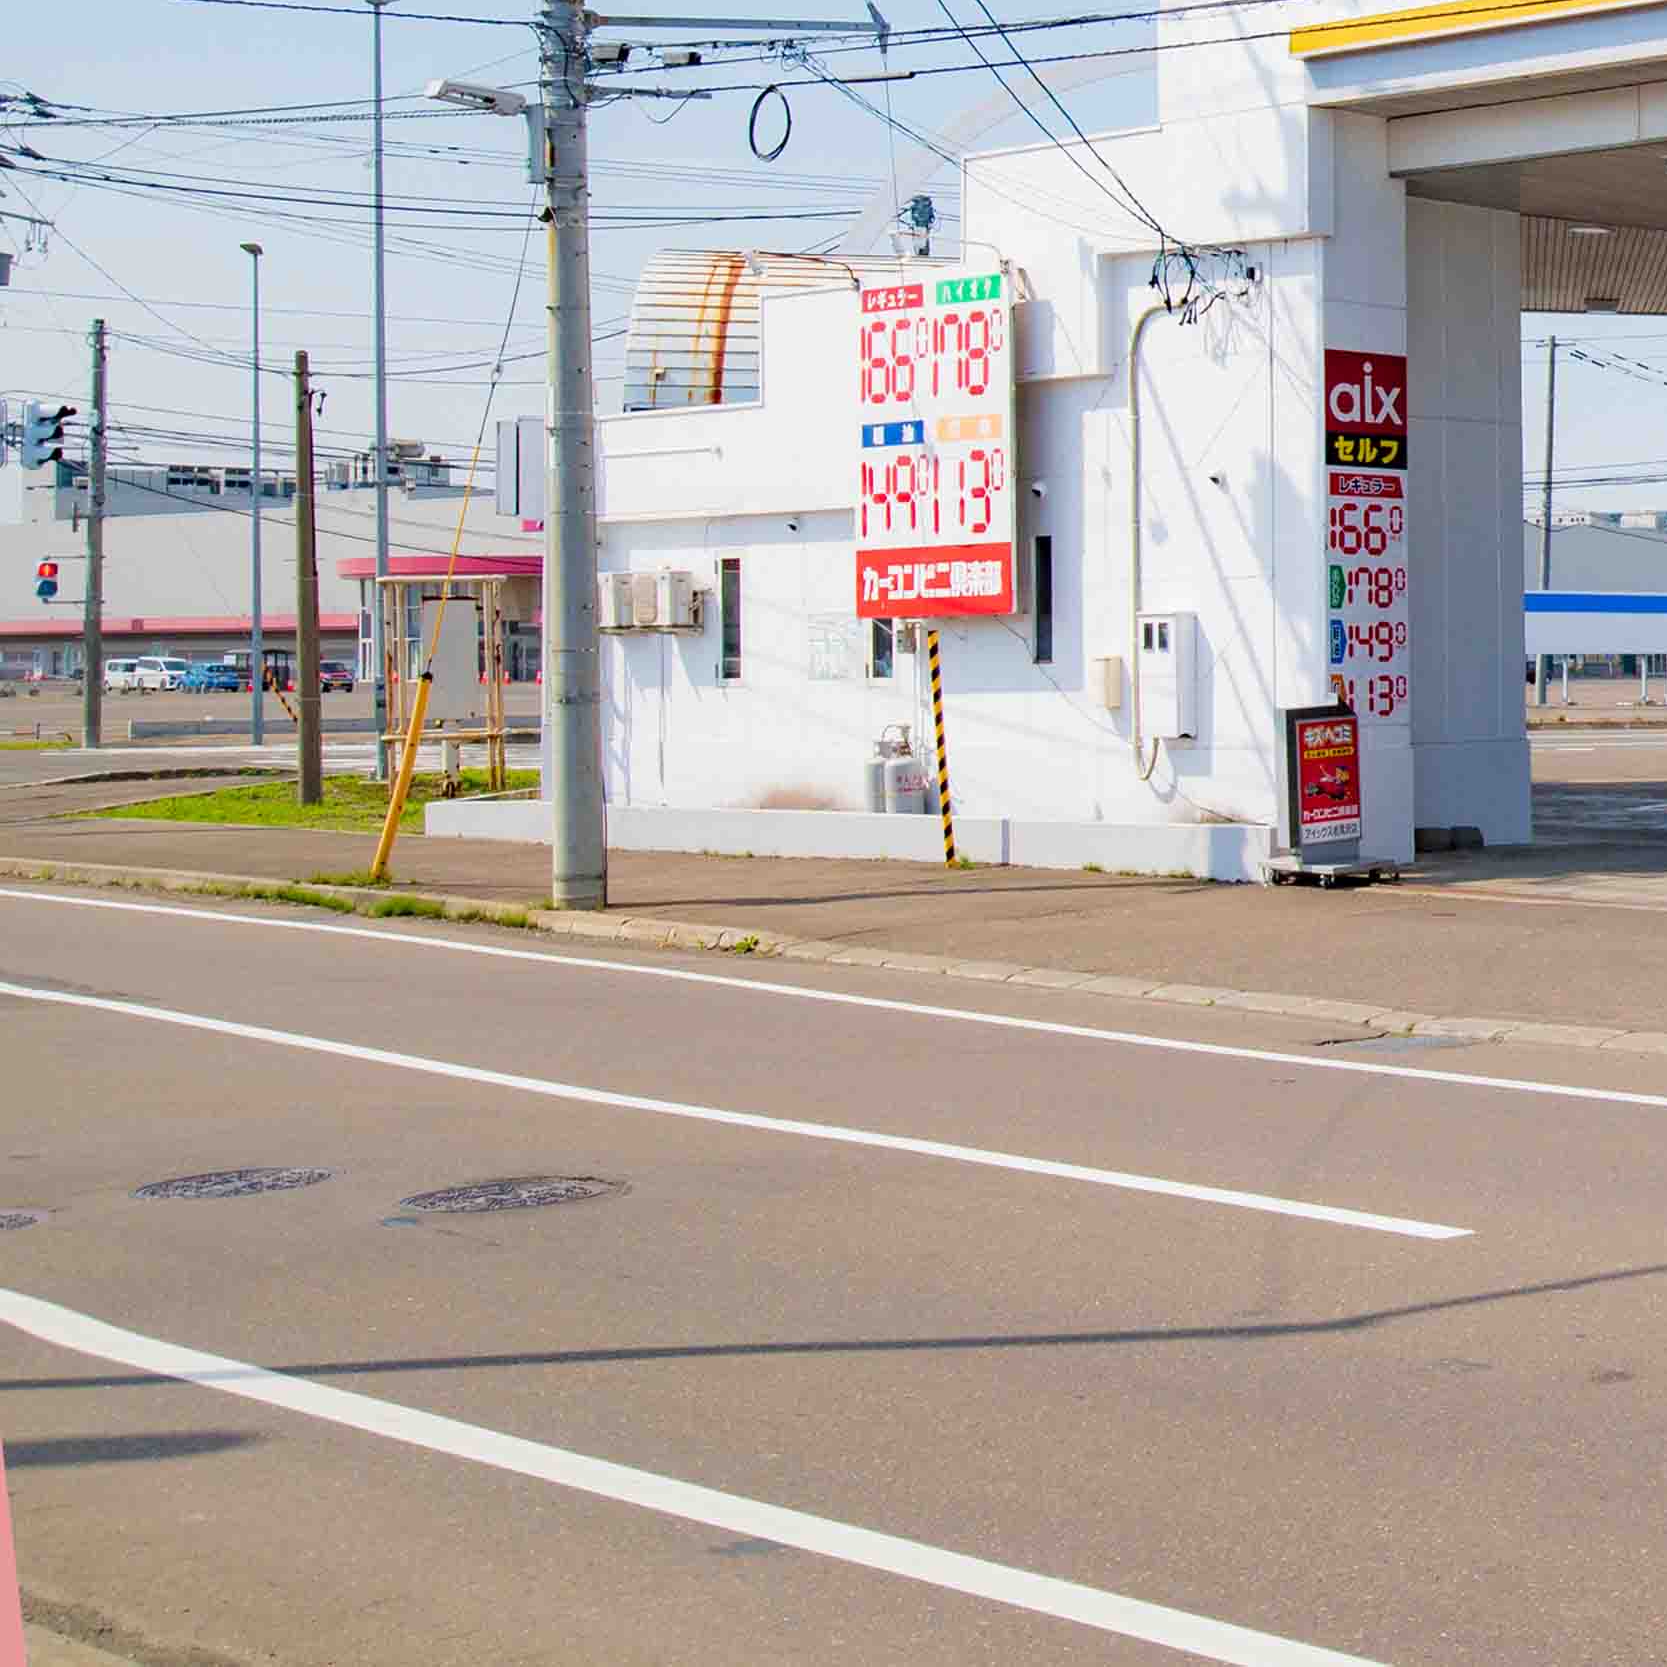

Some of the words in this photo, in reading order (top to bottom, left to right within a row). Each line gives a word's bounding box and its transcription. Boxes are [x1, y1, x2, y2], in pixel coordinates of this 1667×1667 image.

[866, 288, 919, 311] レギュラー
[1329, 361, 1402, 425] aix
[1335, 435, 1400, 464] セルフ
[1338, 476, 1396, 495] レギュラー
[863, 560, 1003, 602] カーコンビニ倶楽部
